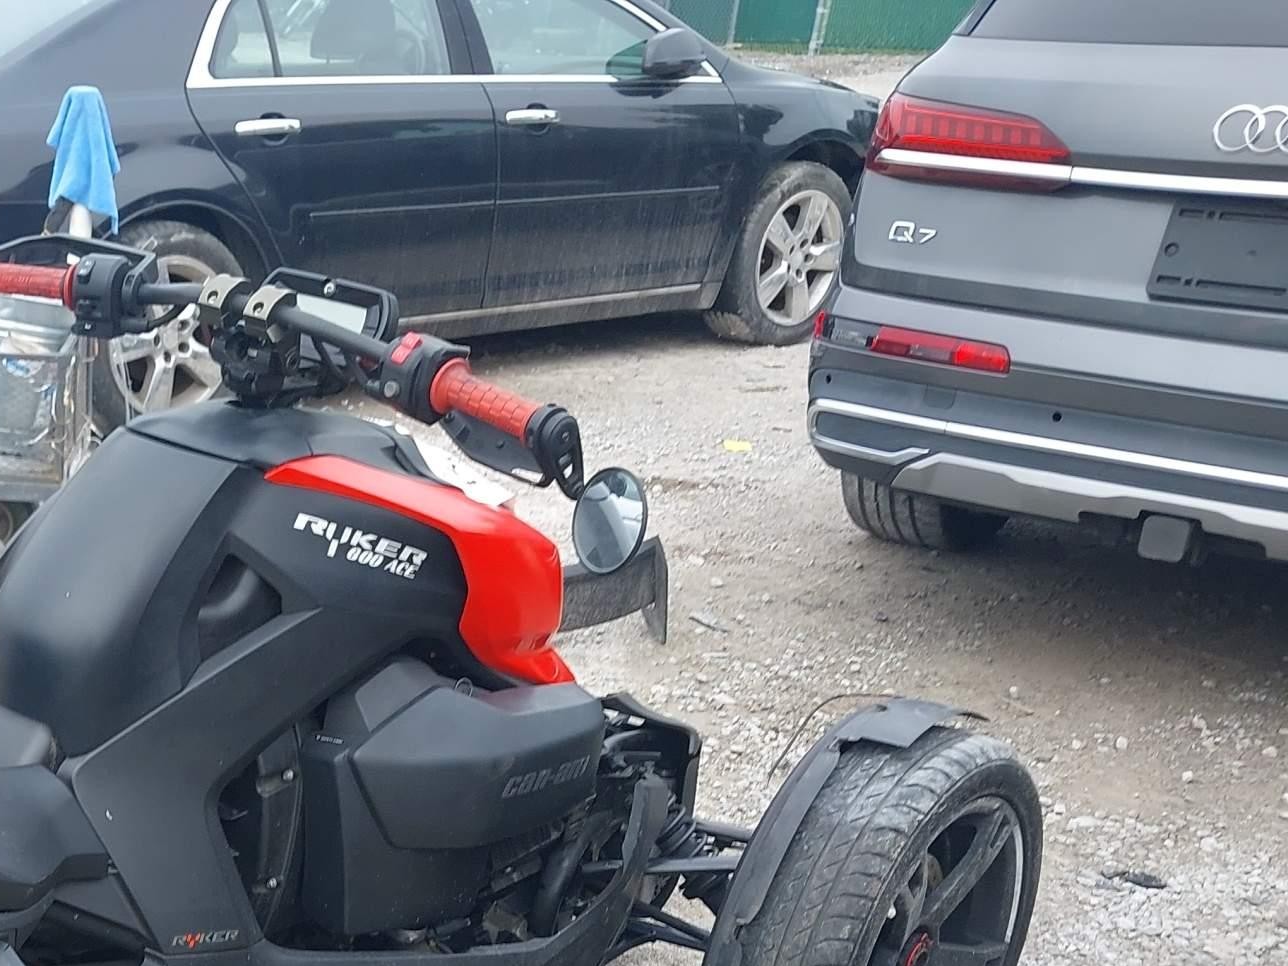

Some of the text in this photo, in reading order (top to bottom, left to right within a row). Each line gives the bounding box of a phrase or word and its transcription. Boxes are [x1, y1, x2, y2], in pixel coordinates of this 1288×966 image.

[888, 220, 938, 244] Q7
[293, 512, 429, 570] RYKER
[384, 558, 419, 580] ACE
[171, 929, 240, 950] RYKER
